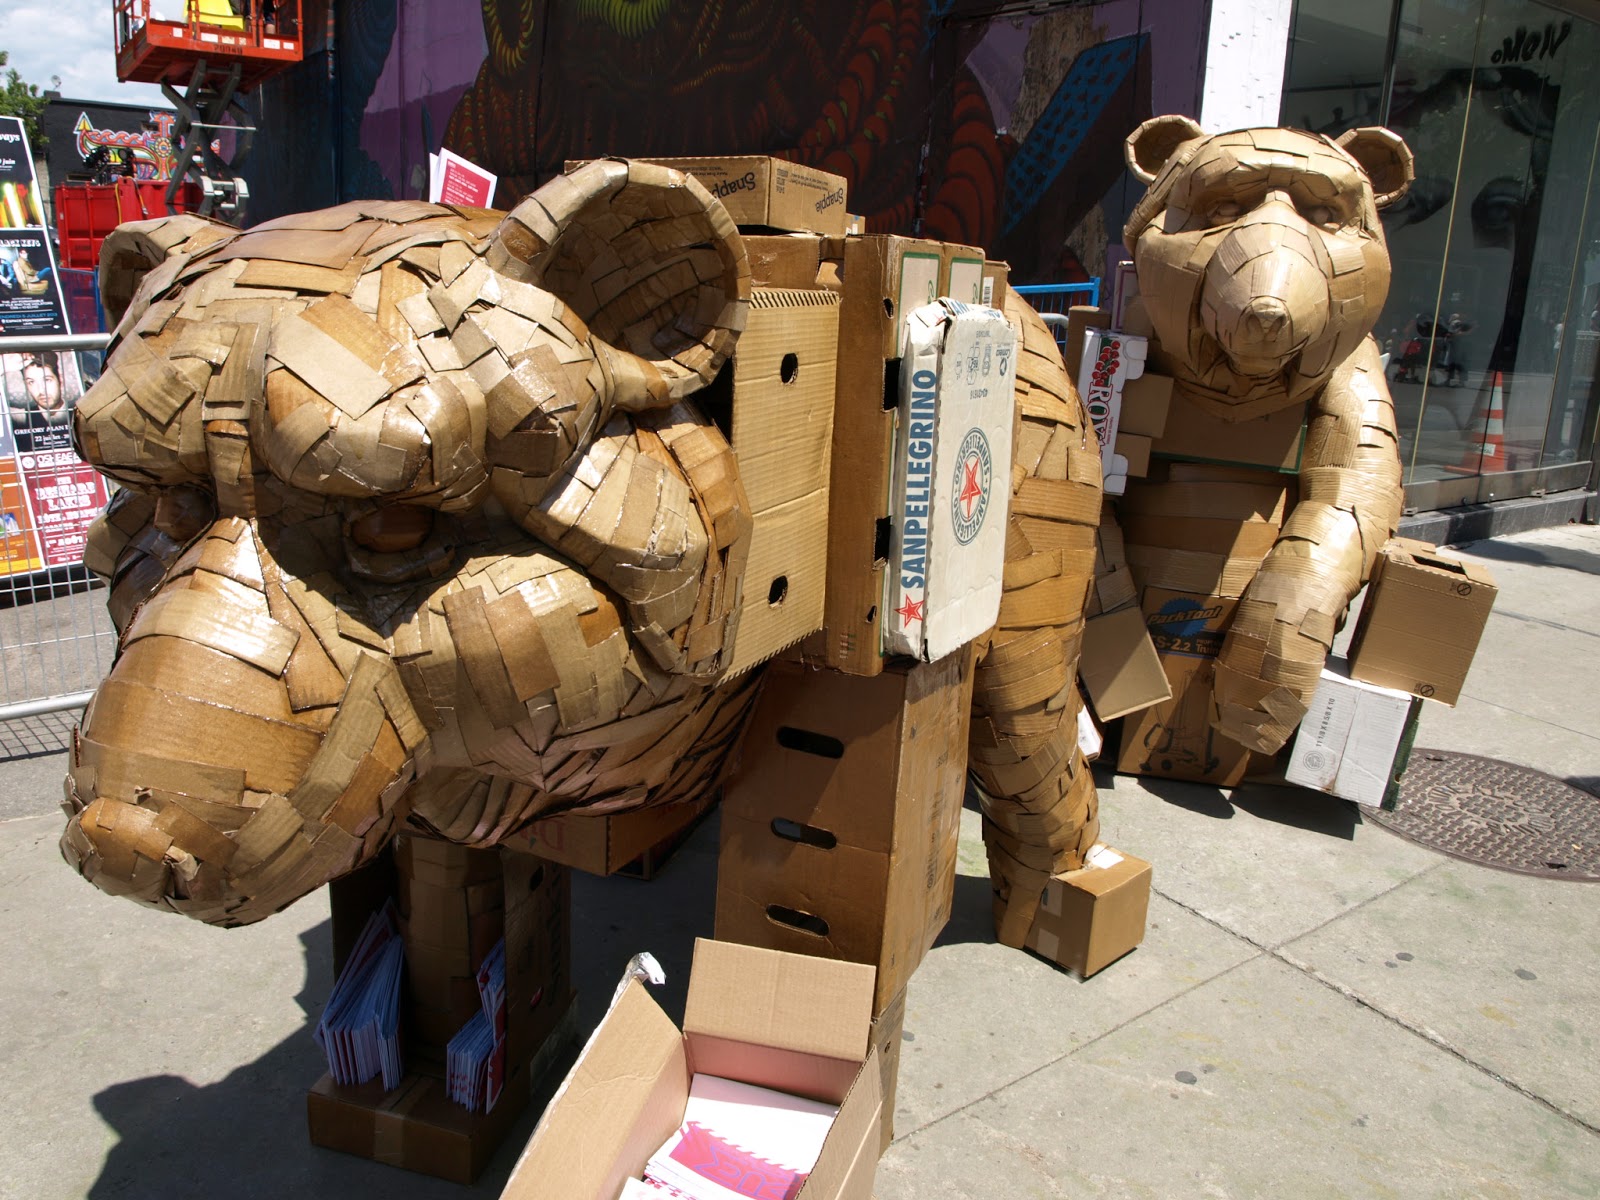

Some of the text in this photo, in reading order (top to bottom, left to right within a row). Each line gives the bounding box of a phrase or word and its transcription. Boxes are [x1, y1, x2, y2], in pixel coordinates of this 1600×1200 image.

[709, 172, 756, 199] Snapp
[815, 187, 844, 215] Snapple
[901, 369, 937, 588] SANPELLEGRINO
